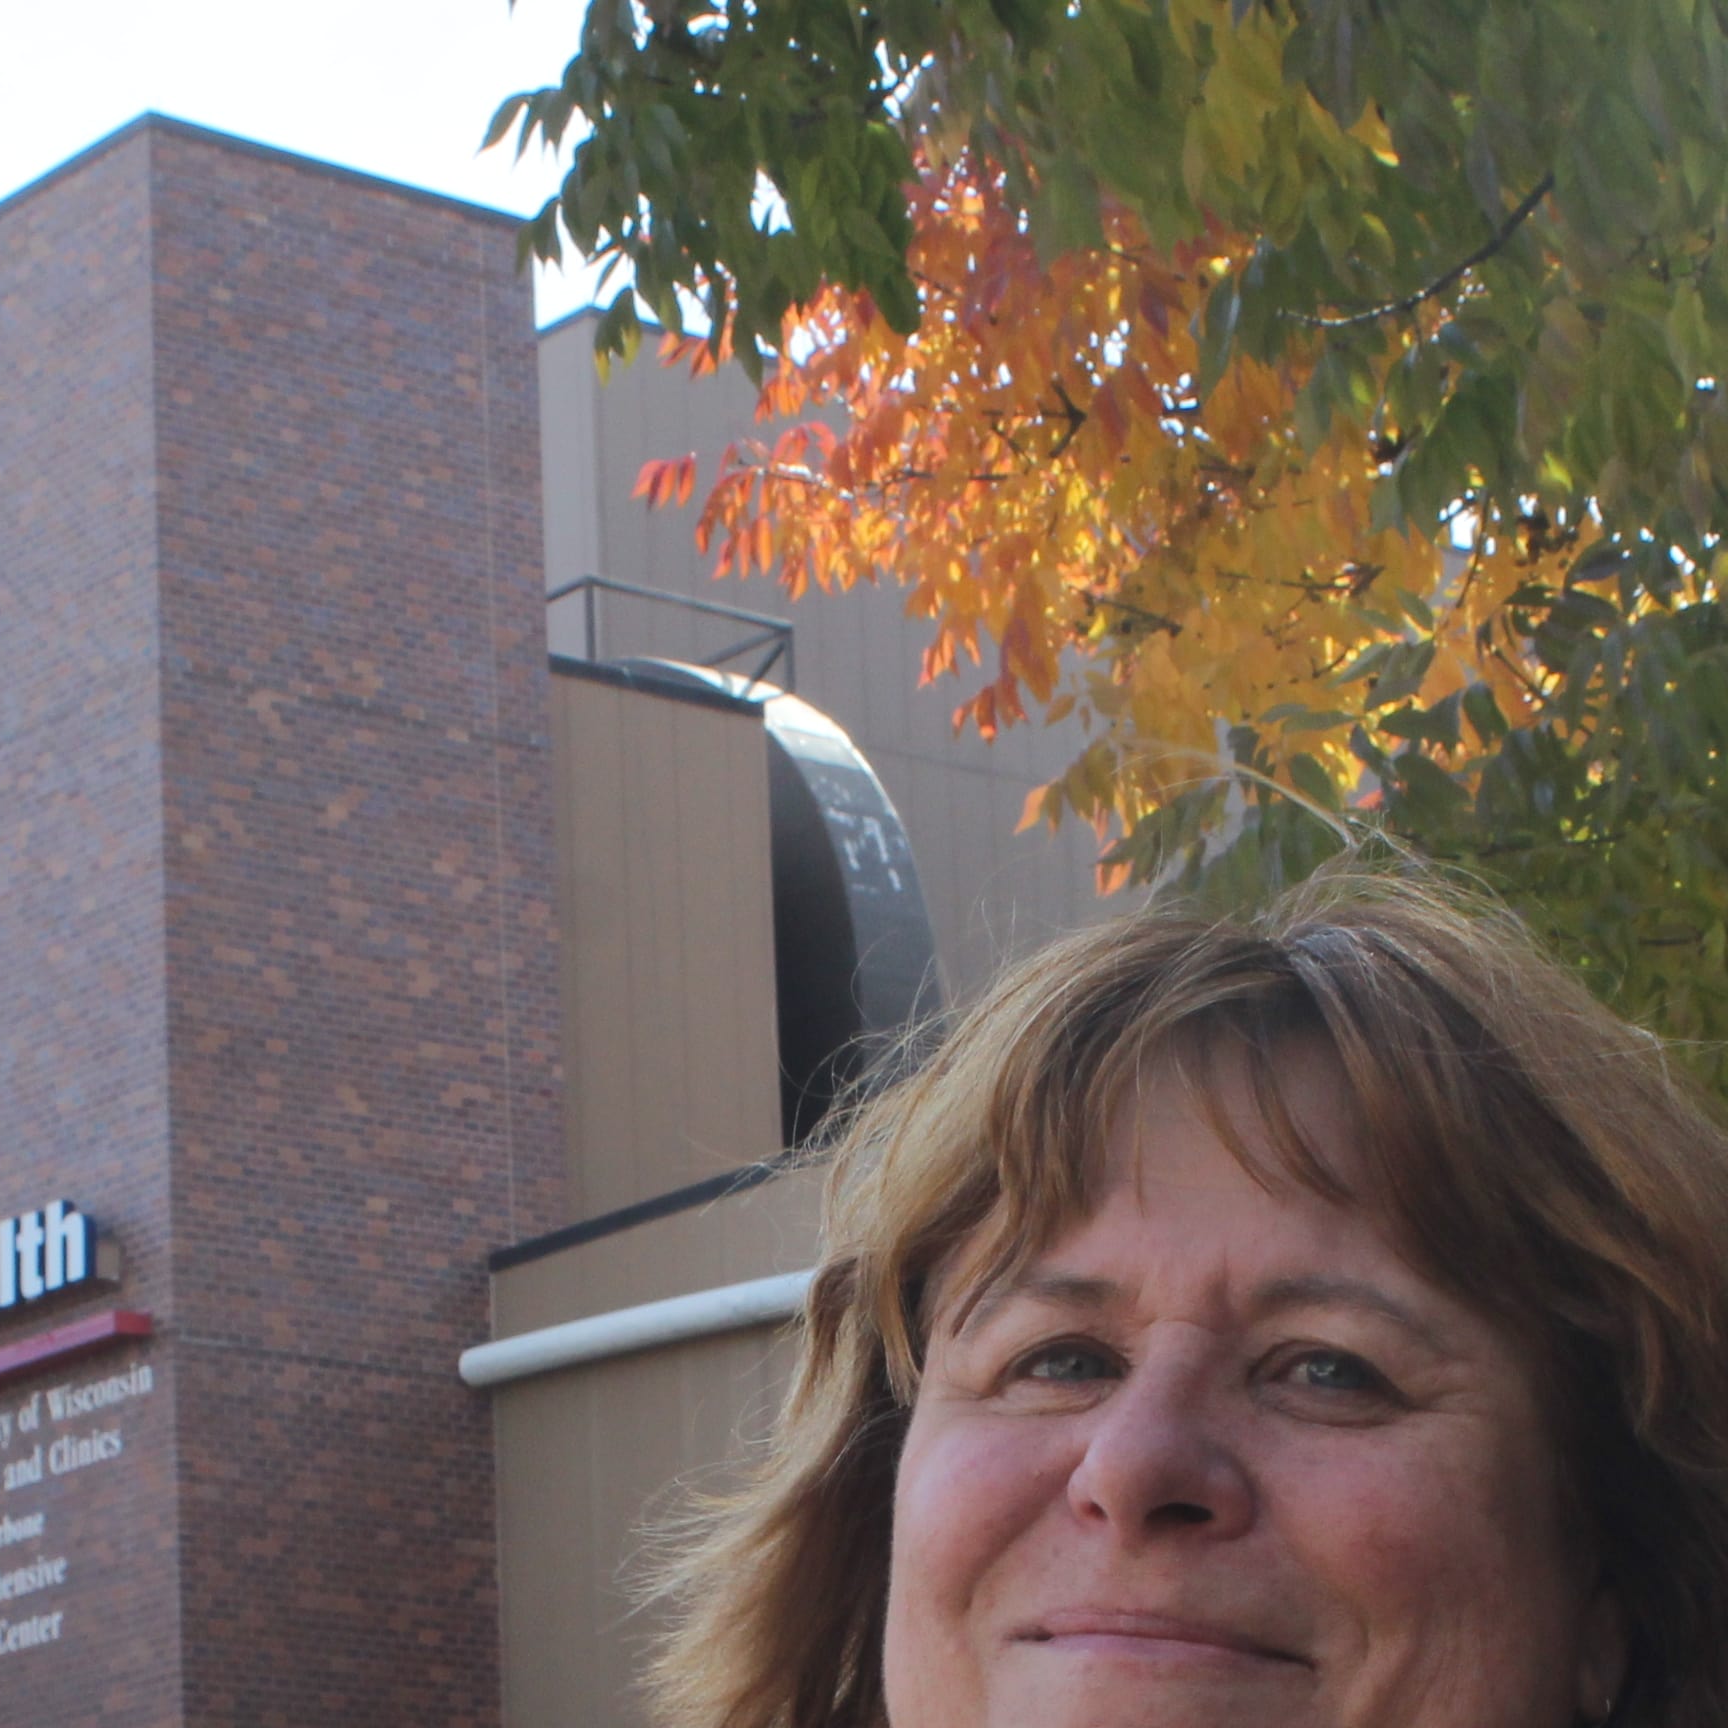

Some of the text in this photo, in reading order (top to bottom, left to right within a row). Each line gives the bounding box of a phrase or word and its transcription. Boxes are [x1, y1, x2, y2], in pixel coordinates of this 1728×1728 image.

[17, 1400, 40, 1435] of
[46, 1363, 154, 1421] Wisconsin
[3, 1449, 43, 1490] and
[49, 1428, 122, 1475] Clinics
